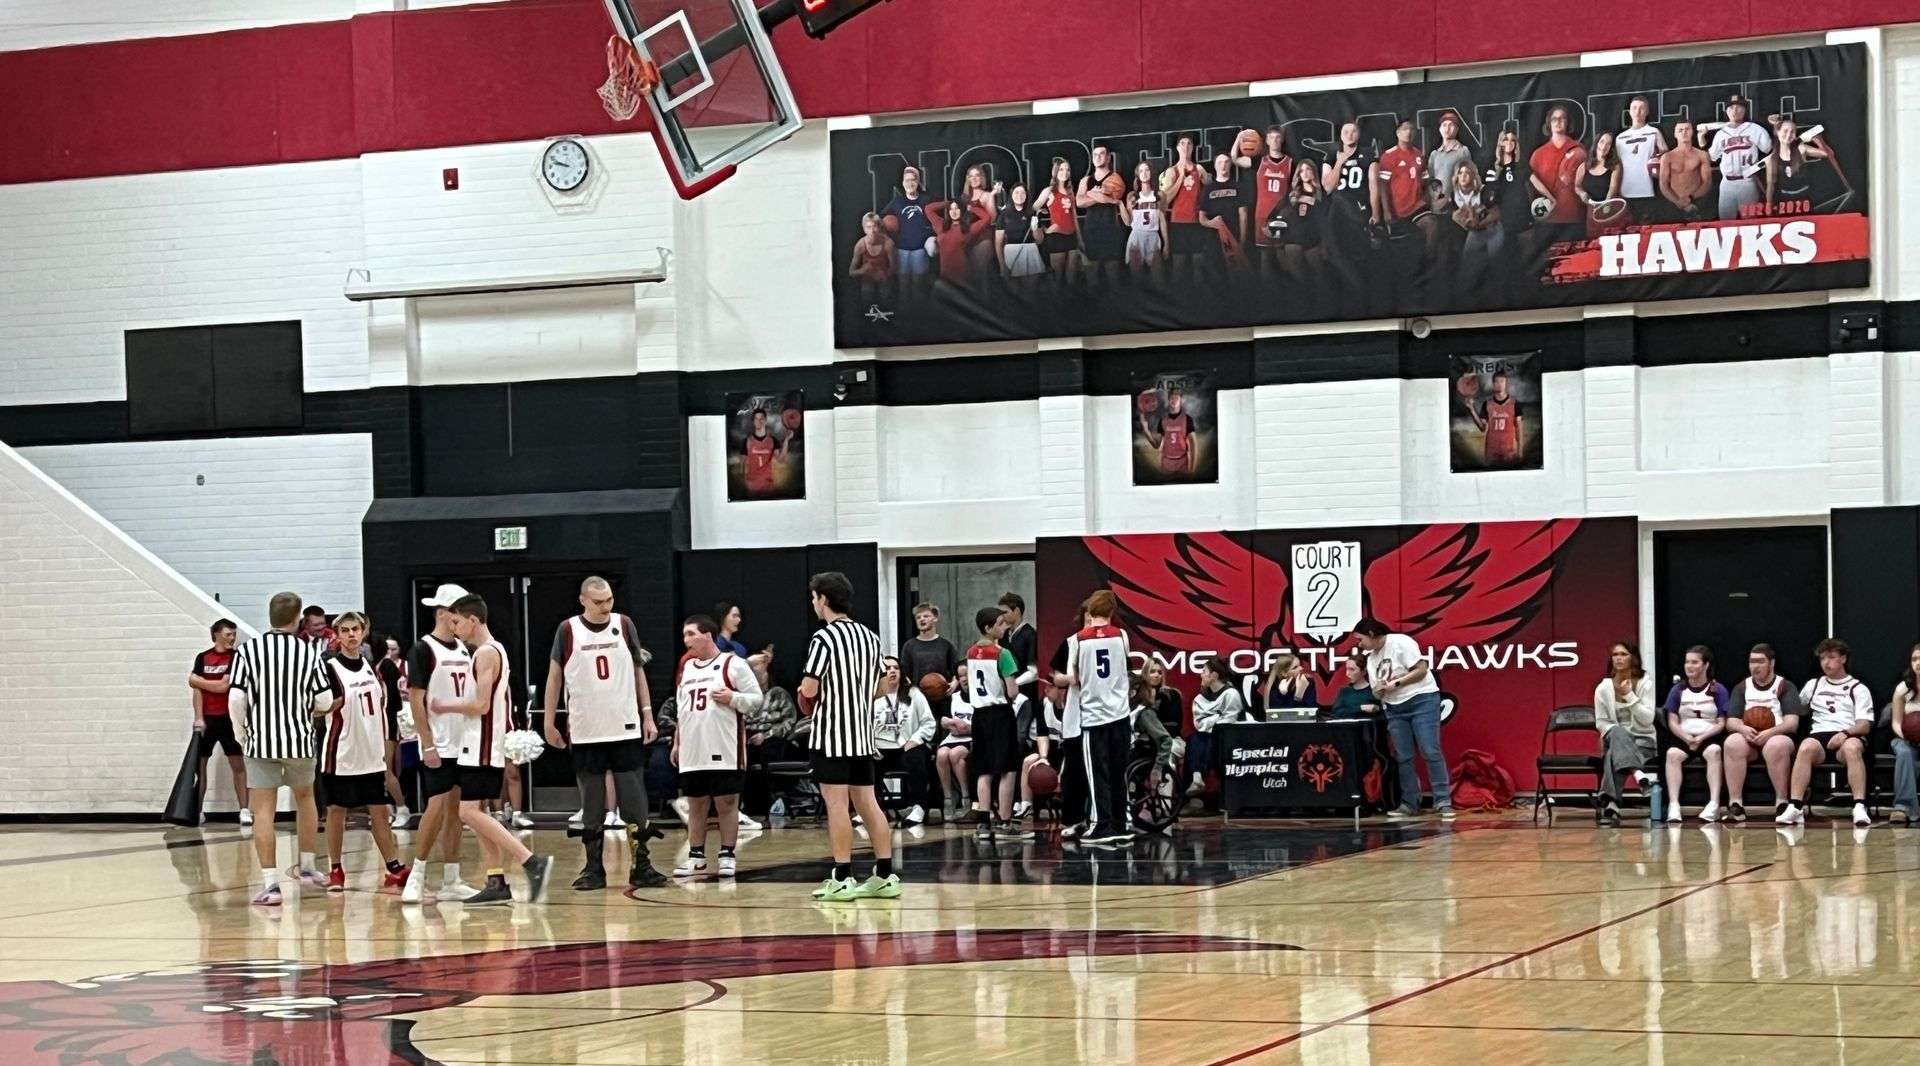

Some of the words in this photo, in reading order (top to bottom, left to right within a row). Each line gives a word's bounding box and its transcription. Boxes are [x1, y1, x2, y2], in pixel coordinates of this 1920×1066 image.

[1599, 220, 1818, 277] HAWKS
[1295, 546, 1355, 569] COURT
[1306, 571, 1339, 628] 2
[595, 655, 610, 680] 0
[1095, 648, 1111, 679] 5
[1127, 650, 1218, 674] OME
[450, 671, 466, 698] 17
[976, 669, 988, 697] 3
[358, 690, 375, 717] 11
[688, 687, 708, 712] 15
[1232, 746, 1289, 761] Special
[1262, 777, 1287, 788] Utah
